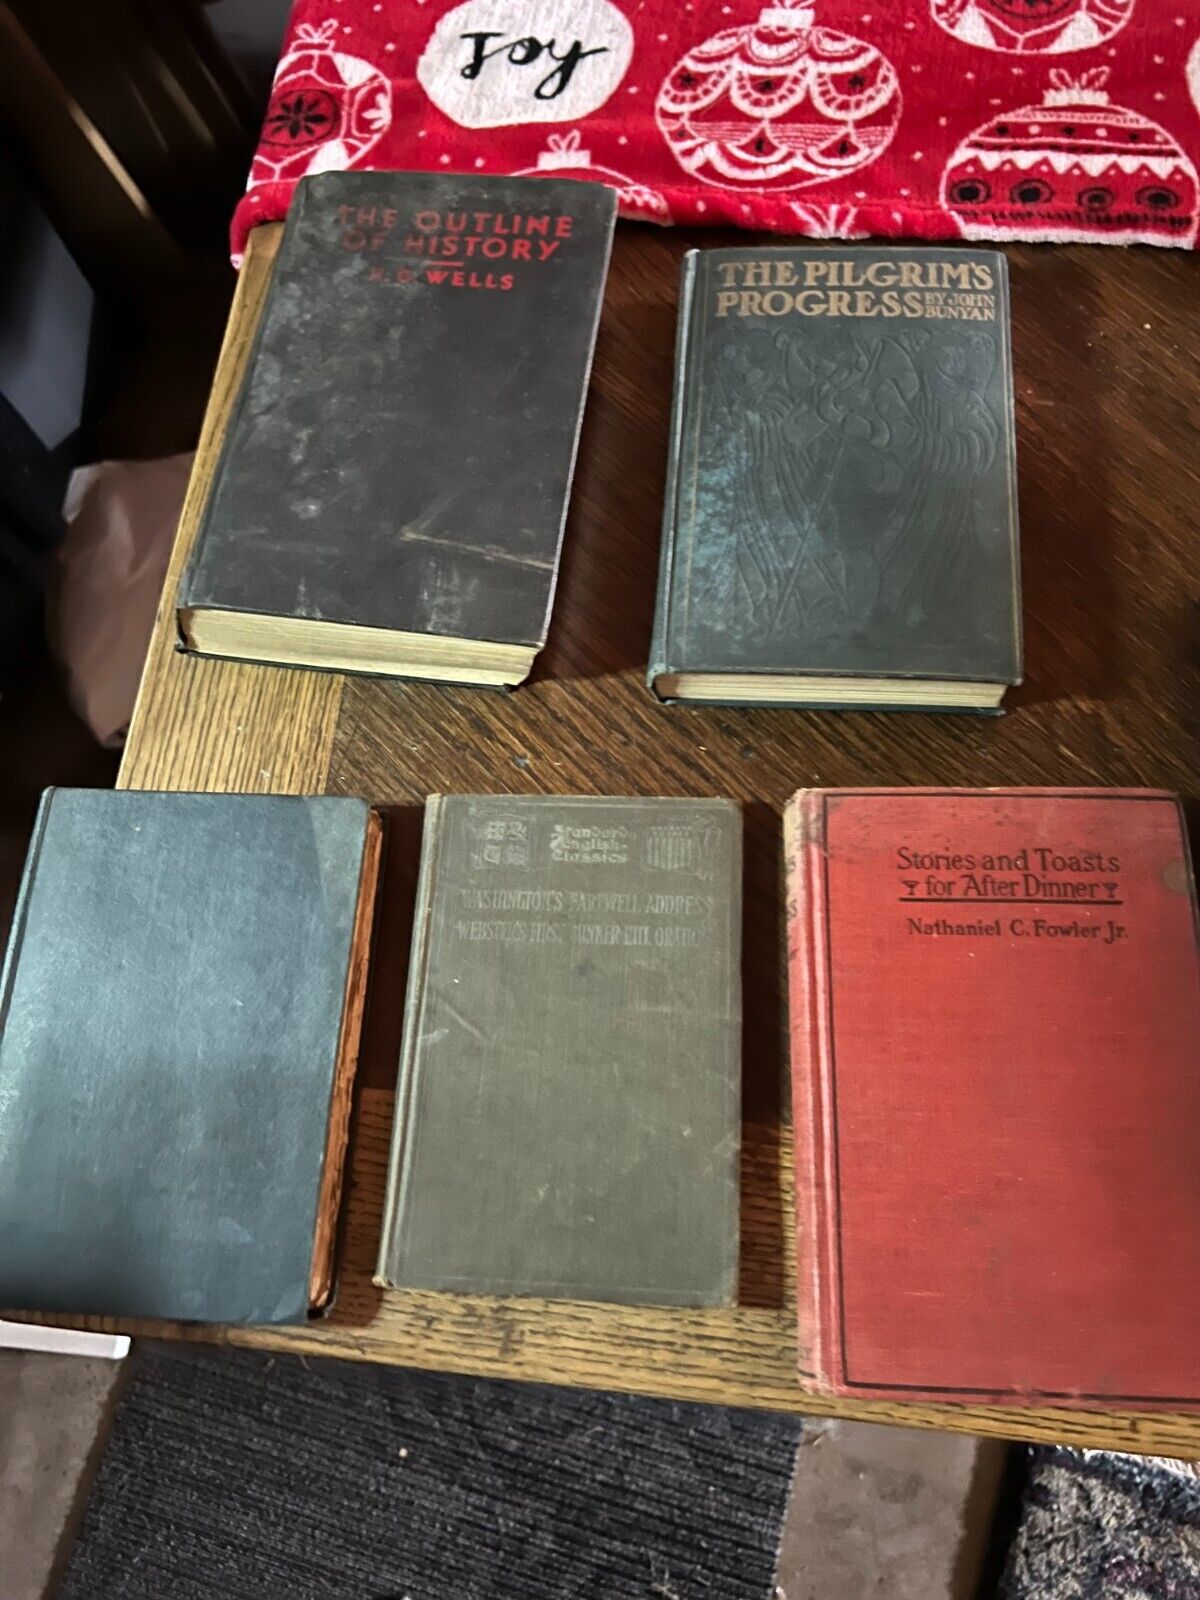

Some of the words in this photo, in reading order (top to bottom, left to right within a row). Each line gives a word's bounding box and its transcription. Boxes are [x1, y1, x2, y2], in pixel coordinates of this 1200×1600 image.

[459, 32, 610, 100] Joy
[338, 204, 398, 228] THE
[416, 209, 574, 238] OUTLINE
[342, 229, 386, 250] OF
[404, 234, 560, 262] HISTORY
[425, 270, 515, 290] WELLS
[716, 260, 799, 287] THE
[802, 260, 995, 291] PILGRIM'S
[715, 290, 924, 318] PROGRESS
[924, 291, 944, 306] BY
[949, 292, 995, 307] JOHN
[925, 306, 995, 320] BUNYAN
[896, 846, 976, 871] Stories
[982, 849, 1030, 871] and
[1035, 848, 1121, 873] Toasts
[925, 875, 956, 896] for
[960, 874, 1019, 898] After
[1023, 874, 1101, 898] Dinner
[907, 918, 1002, 936] Nathaniel
[1009, 919, 1030, 937] C.
[1033, 919, 1101, 938] Fowler
[1105, 920, 1128, 945] Jr.
